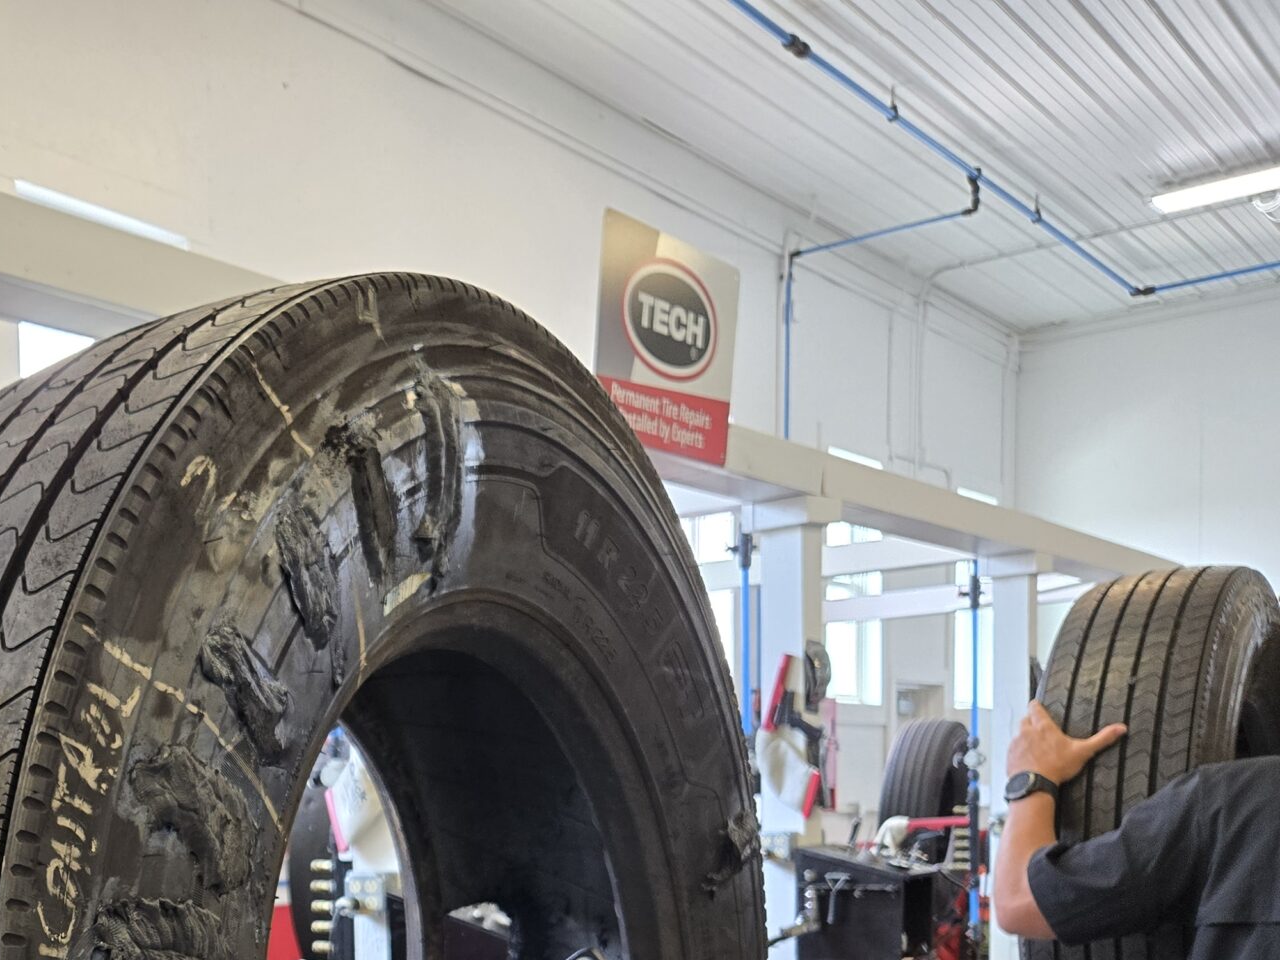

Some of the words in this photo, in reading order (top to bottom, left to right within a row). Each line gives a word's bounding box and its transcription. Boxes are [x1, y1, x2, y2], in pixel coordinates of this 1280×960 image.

[638, 292, 706, 349] TECH
[610, 381, 660, 415] Permanent
[662, 396, 680, 420] Tire
[660, 417, 671, 444] by
